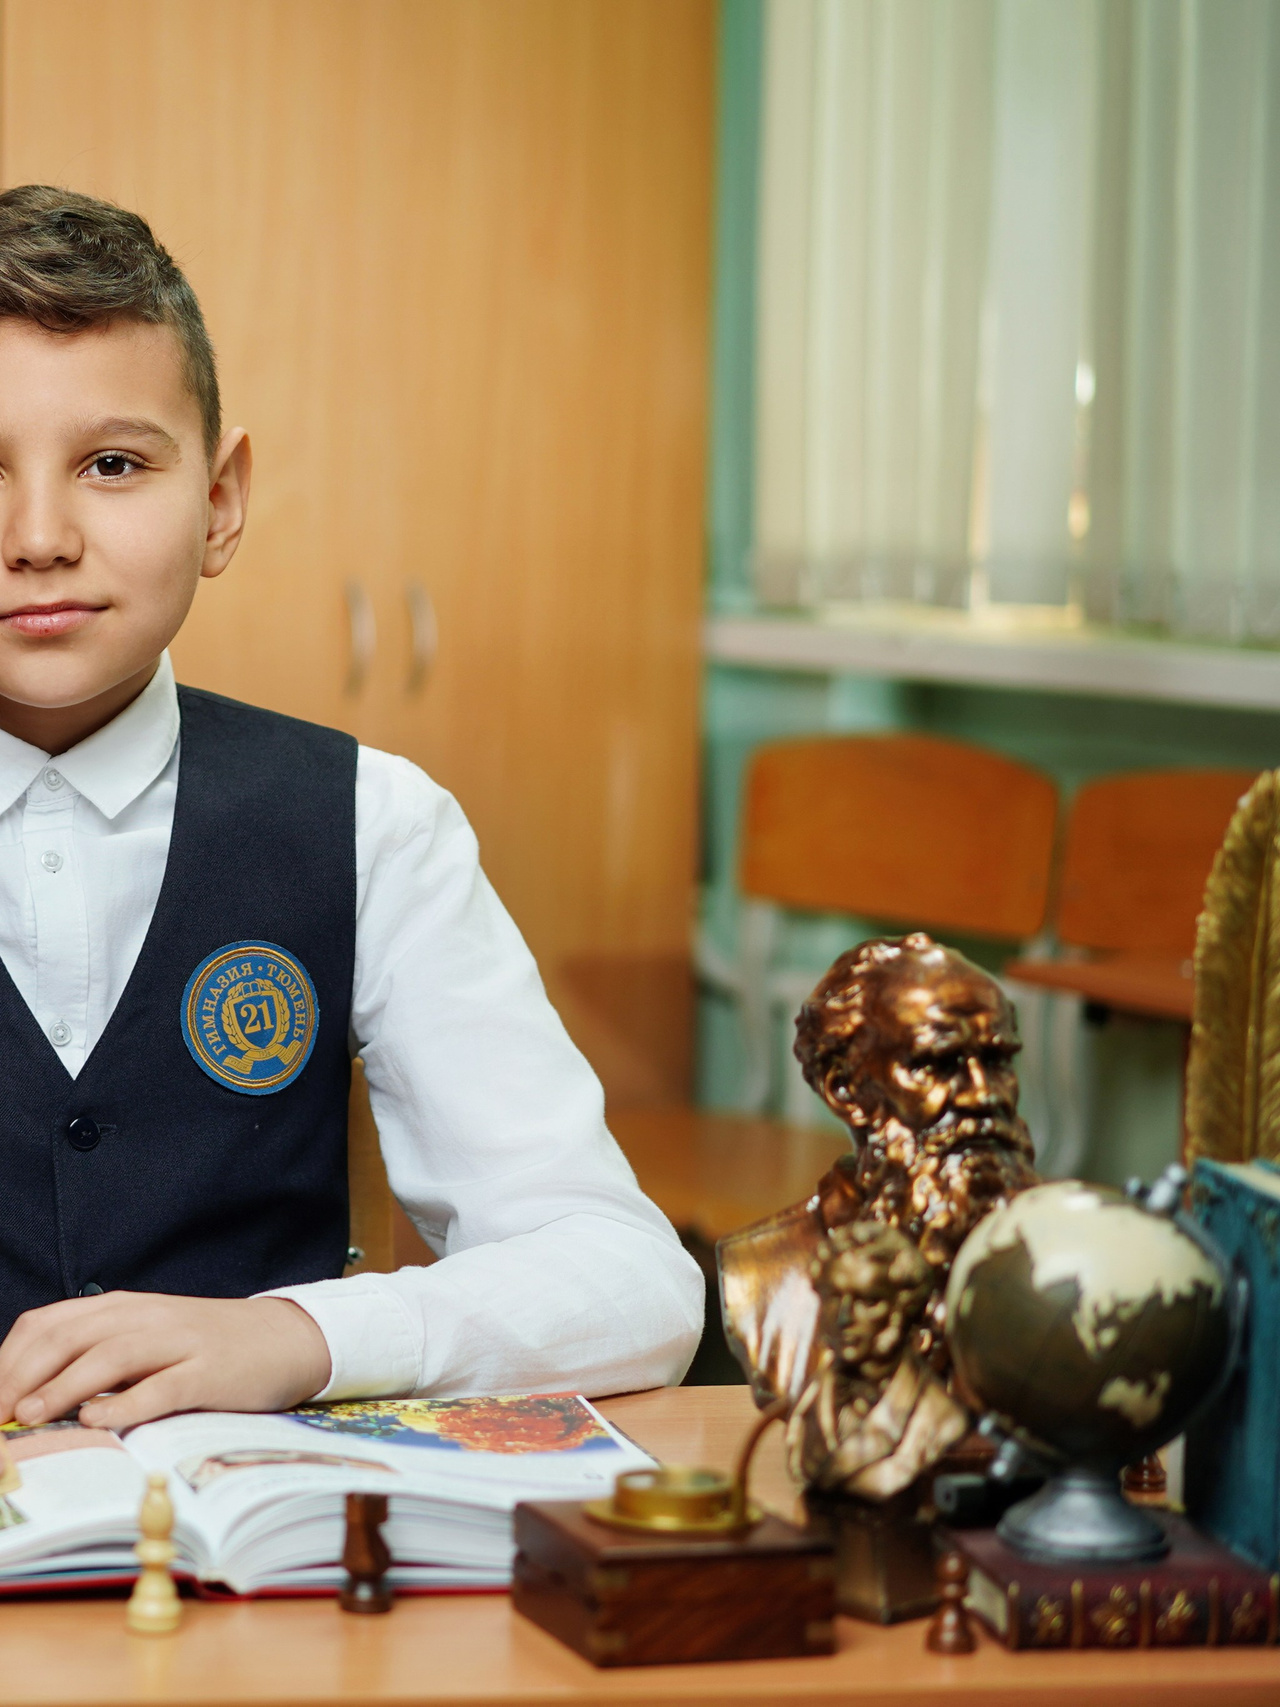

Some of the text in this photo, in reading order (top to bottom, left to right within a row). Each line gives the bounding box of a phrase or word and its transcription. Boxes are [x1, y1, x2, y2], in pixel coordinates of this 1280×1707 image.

[202, 962, 306, 1056] ГИМНАЗИЯ ТЮМЕНЬ
[240, 999, 274, 1035] 21
